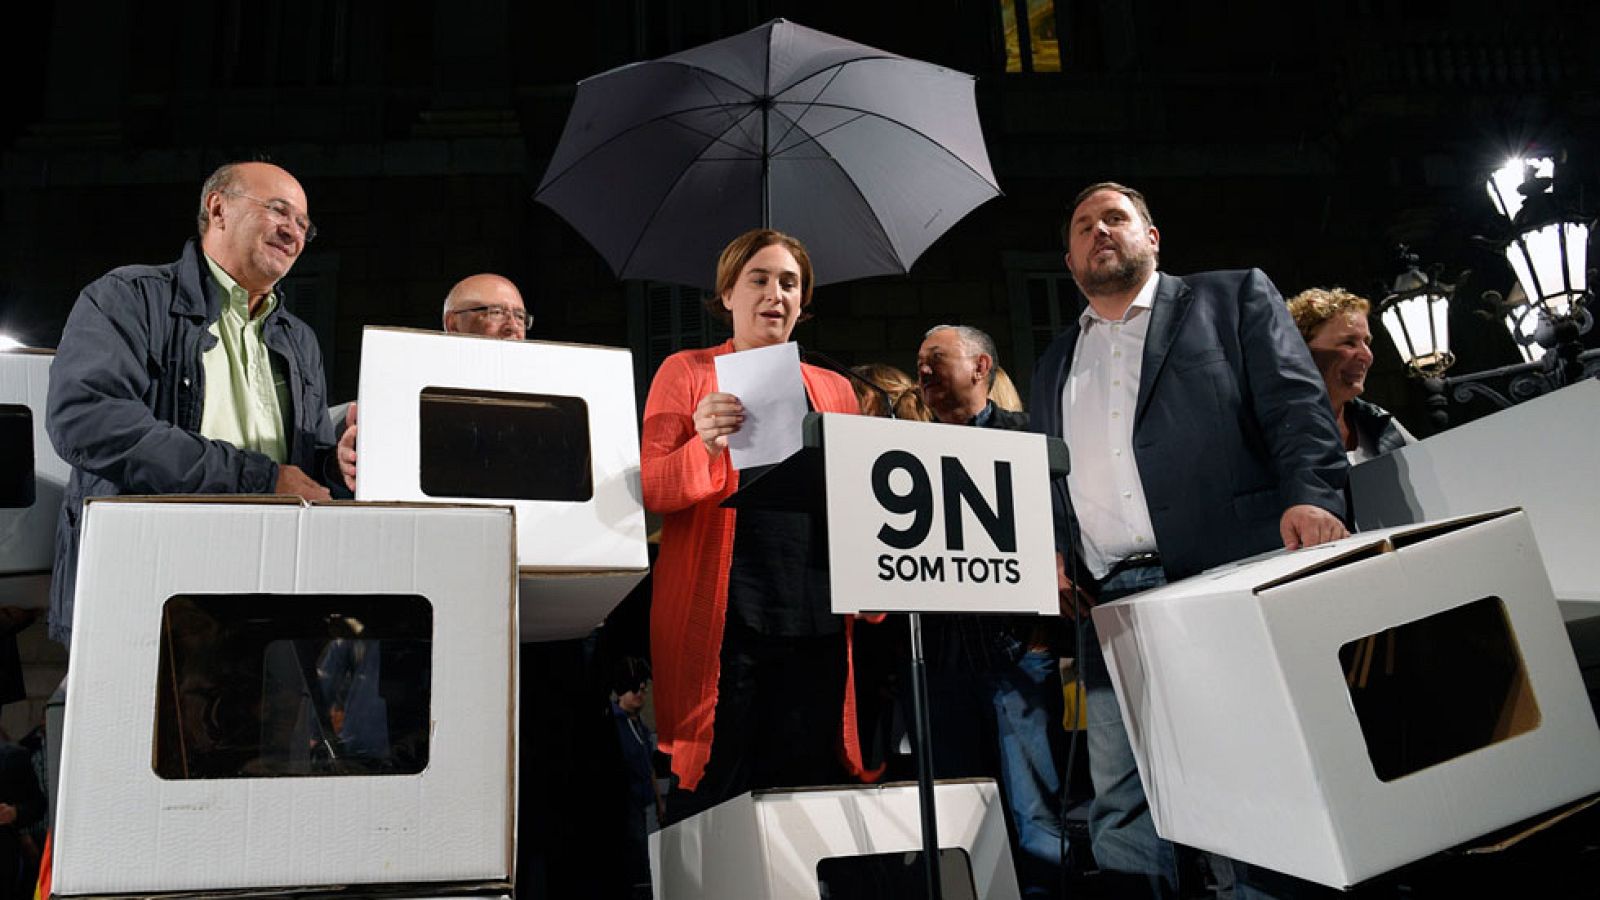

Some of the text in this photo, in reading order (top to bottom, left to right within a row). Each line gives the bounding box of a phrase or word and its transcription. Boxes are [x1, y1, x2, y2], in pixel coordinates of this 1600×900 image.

[871, 449, 1018, 553] 9N
[877, 553, 1021, 584] SOM TOTS
